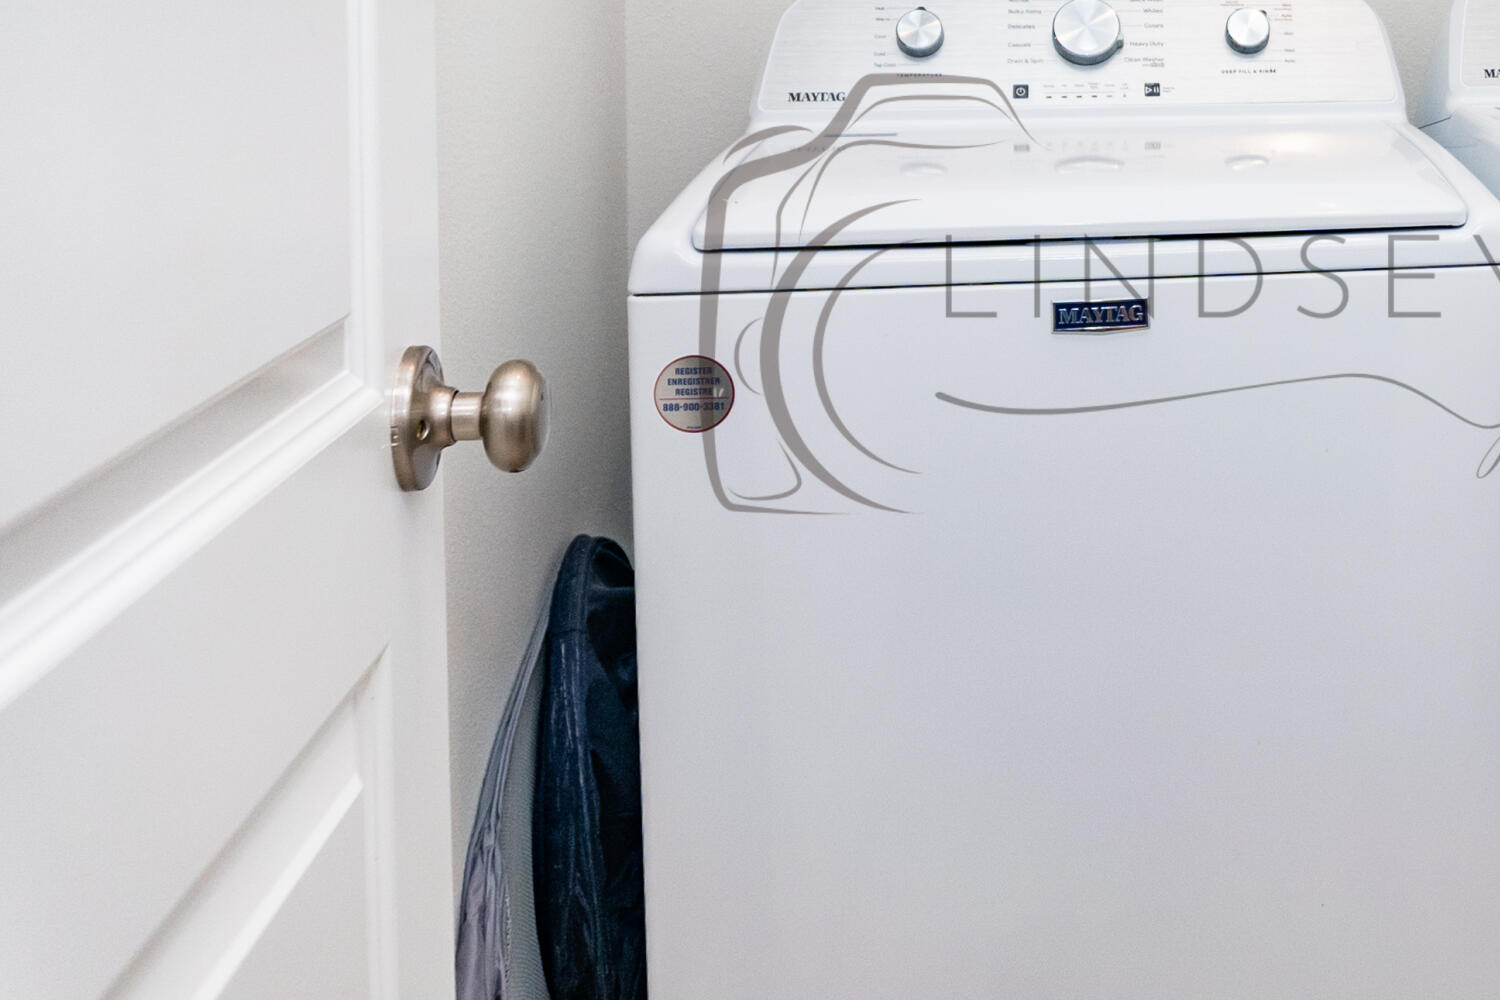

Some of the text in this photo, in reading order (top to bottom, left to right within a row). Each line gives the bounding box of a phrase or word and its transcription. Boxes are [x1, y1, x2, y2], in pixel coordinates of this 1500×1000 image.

[788, 92, 847, 102] MAYTAG
[1058, 304, 1143, 325] MAYTAG
[675, 367, 712, 375] REGISTER
[667, 377, 720, 386] ENREGISTRER
